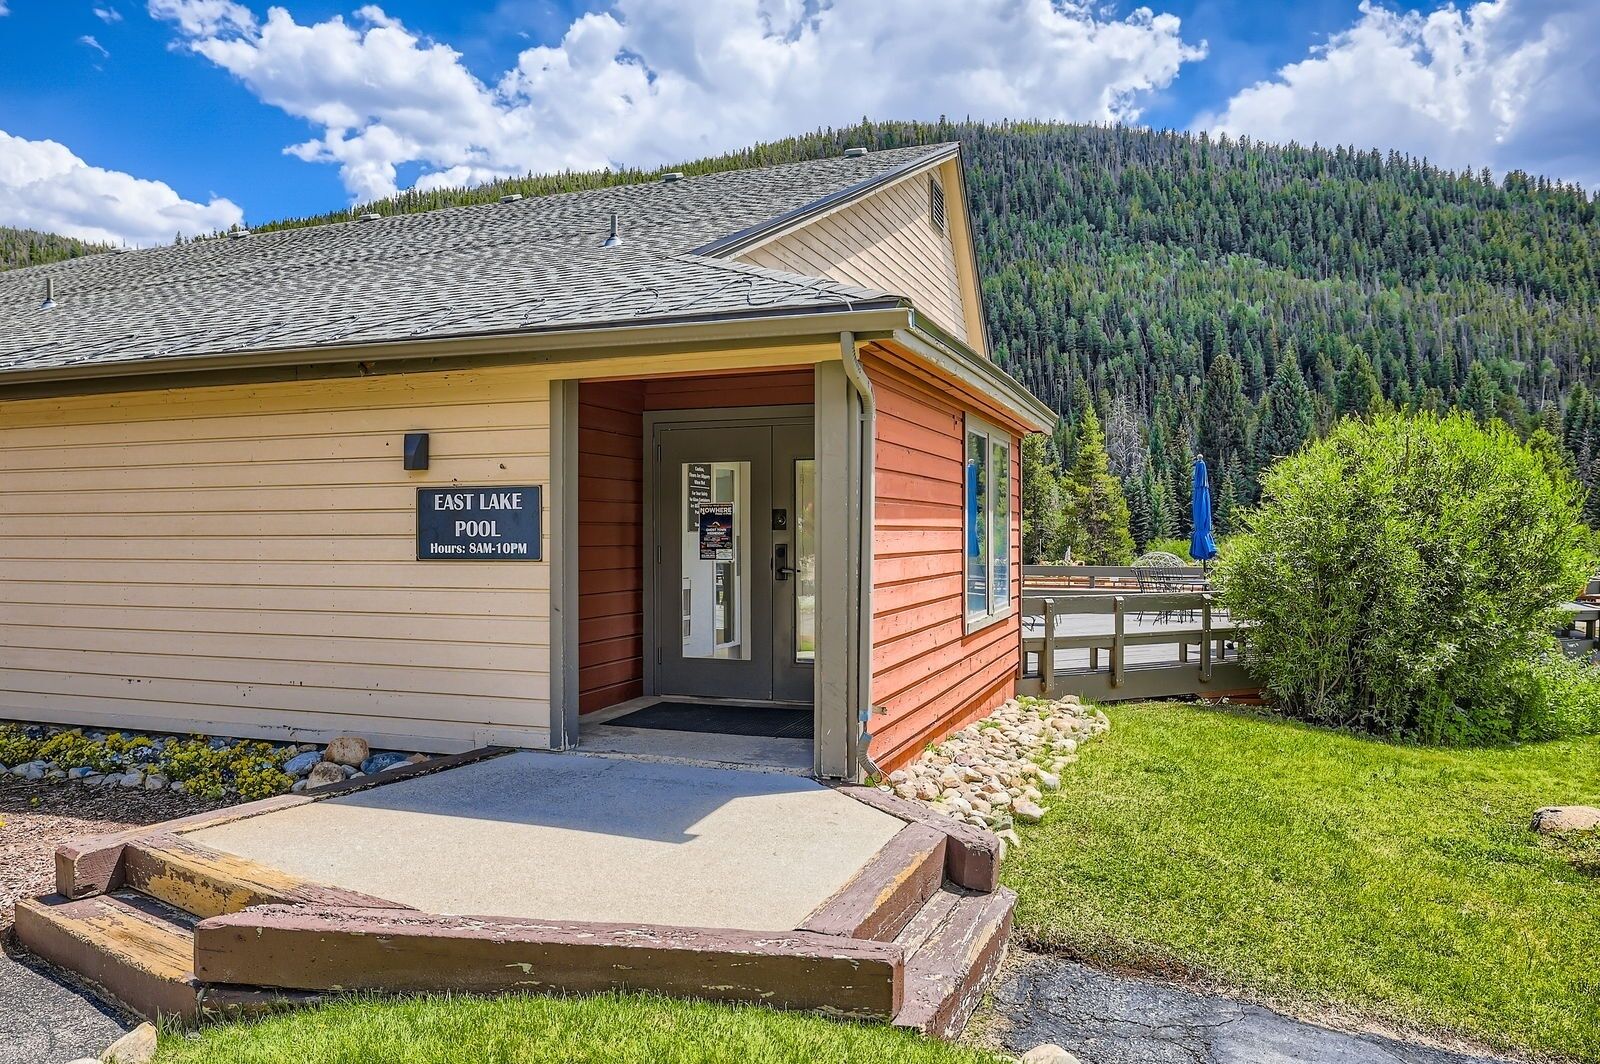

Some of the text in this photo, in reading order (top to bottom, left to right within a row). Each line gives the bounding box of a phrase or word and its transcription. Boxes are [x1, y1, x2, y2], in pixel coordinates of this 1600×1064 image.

[434, 493, 523, 511] EAST LAKE
[700, 507, 732, 515] NOWHERE
[455, 520, 502, 537] POOL
[430, 542, 527, 554] Hours: 8AM-10PM
